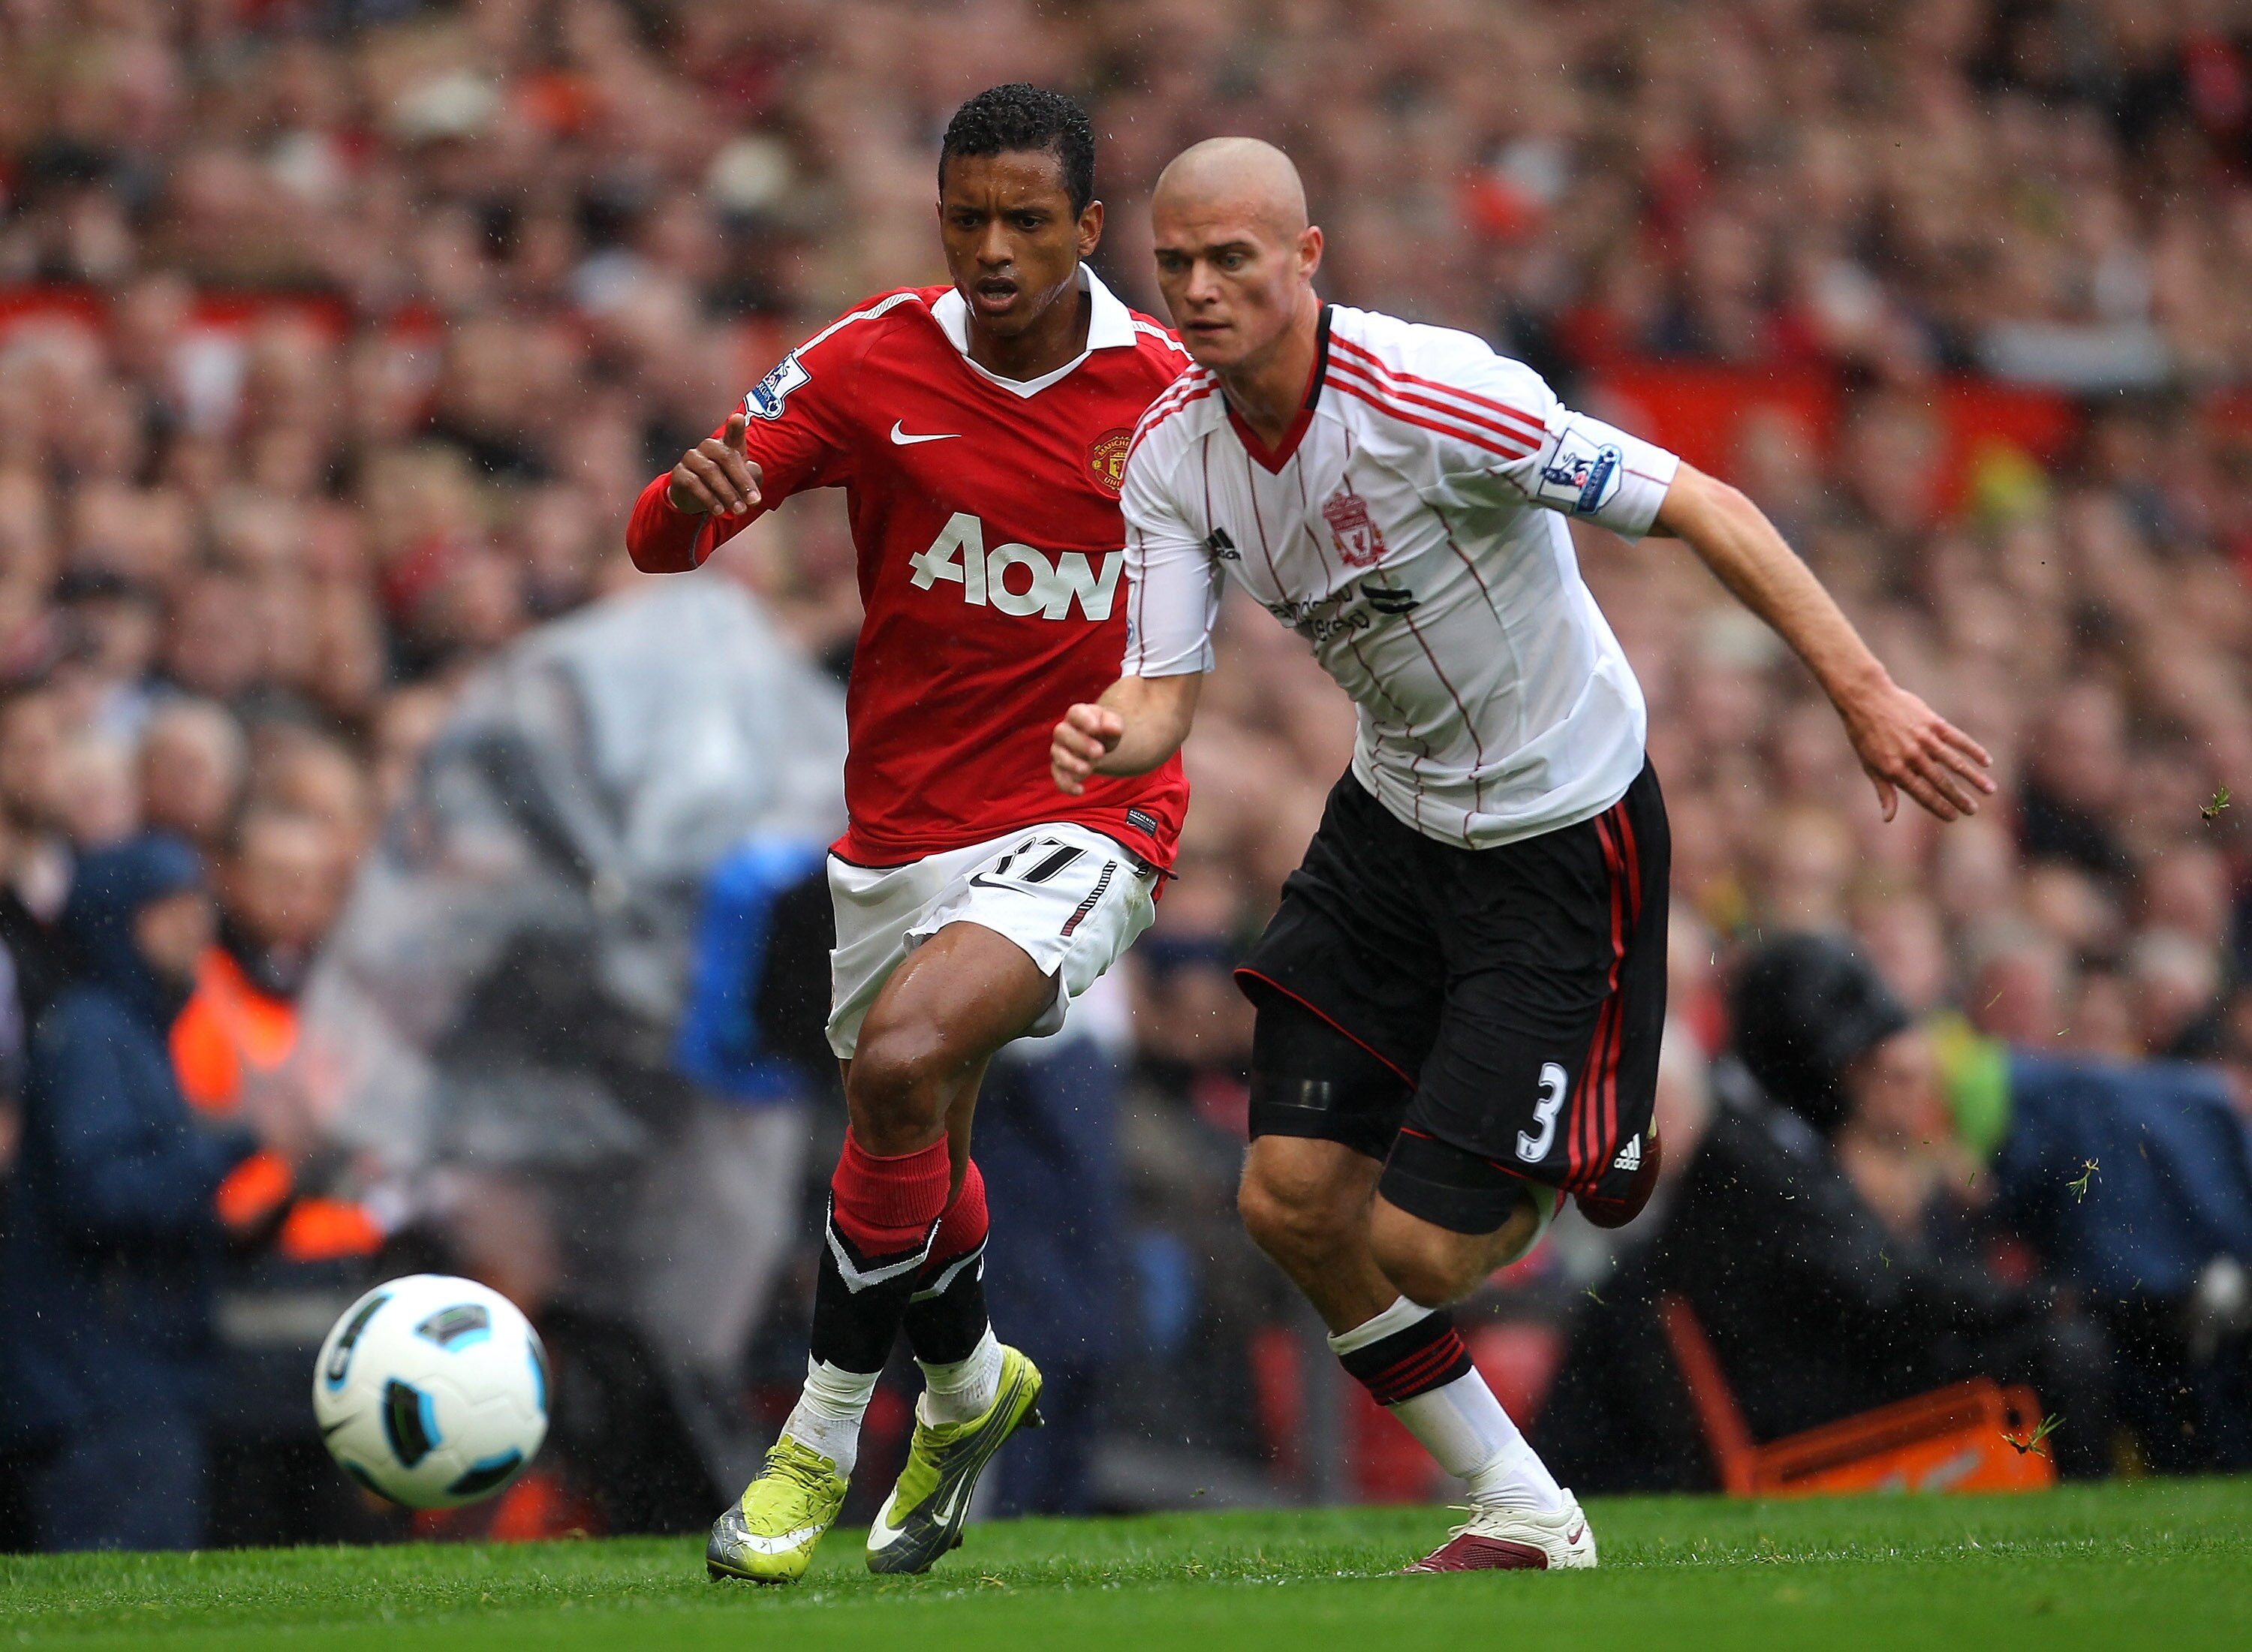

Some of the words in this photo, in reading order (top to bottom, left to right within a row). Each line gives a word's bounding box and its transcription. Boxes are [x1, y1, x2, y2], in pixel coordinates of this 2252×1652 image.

[908, 512, 1124, 621] AON
[1130, 810, 1157, 826] AUTHENTIC
[1515, 1061, 1569, 1163] 3
